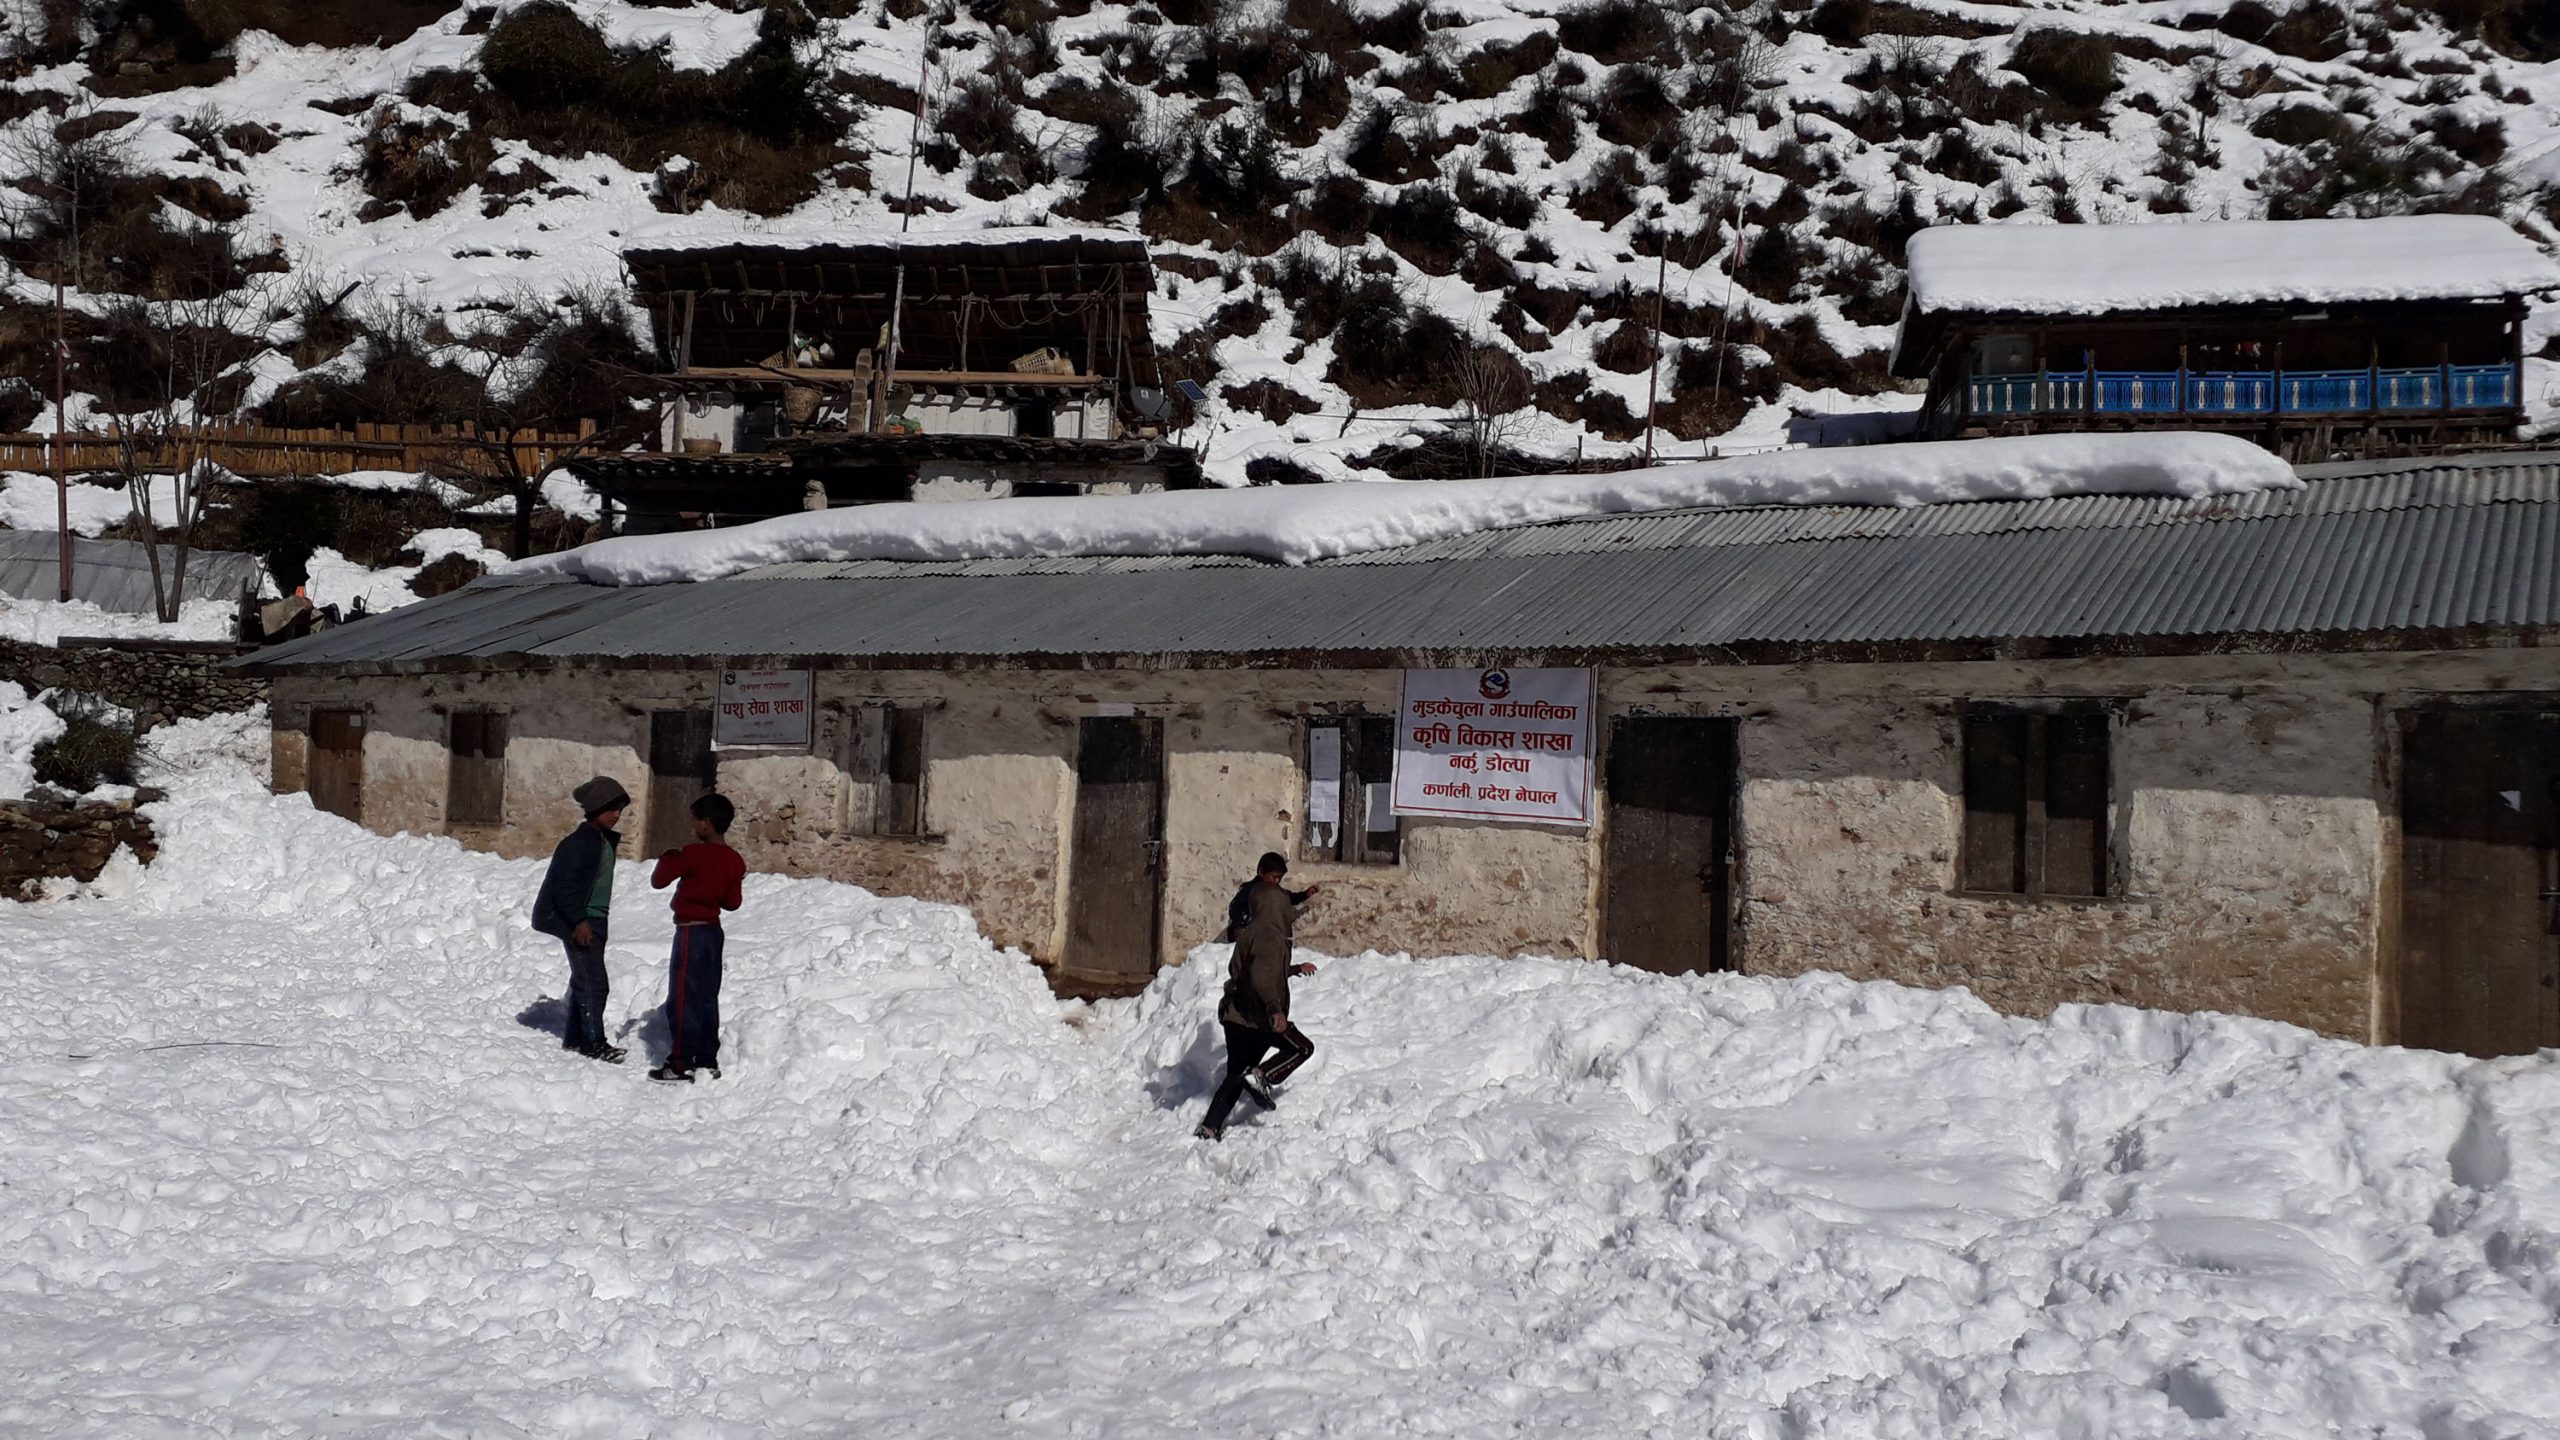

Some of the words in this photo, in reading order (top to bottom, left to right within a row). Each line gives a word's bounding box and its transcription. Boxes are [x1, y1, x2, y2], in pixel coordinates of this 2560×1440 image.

[723, 702, 744, 719] पशु
[748, 698, 769, 716] सेवा
[774, 699, 804, 715] शाखा
[1489, 699, 1578, 720] गाउँपालिका
[1413, 723, 1450, 749] कृषि
[1457, 724, 1515, 749] विकास
[1521, 732, 1573, 751] शाखा
[1486, 753, 1531, 773] डोल्पा
[1478, 784, 1511, 802] प्रदेश
[1515, 785, 1558, 804] नेपाल
